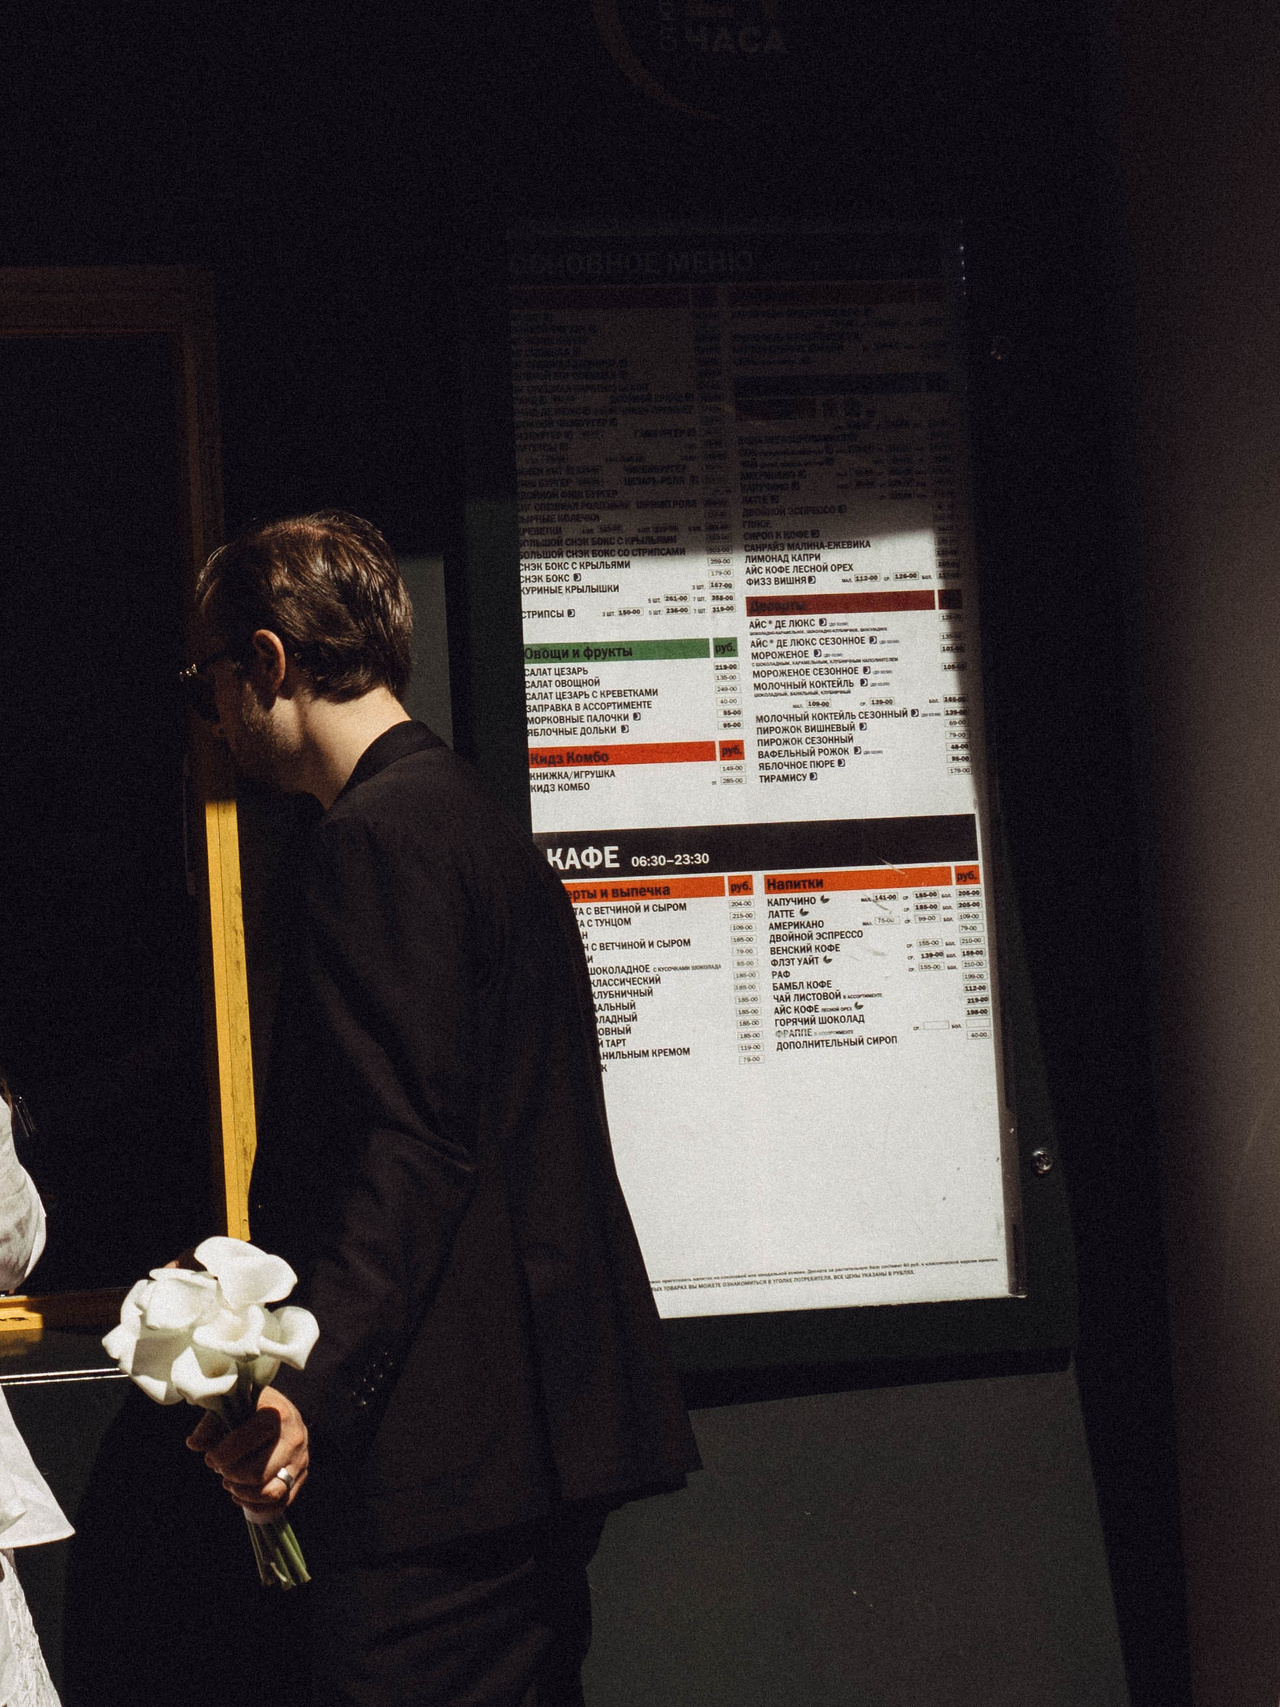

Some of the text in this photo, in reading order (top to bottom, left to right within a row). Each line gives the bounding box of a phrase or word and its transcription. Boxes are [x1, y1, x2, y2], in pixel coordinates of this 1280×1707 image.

[787, 539, 871, 551] МАЛИНА-ЕЖЕВИКА
[566, 549, 590, 559] СНЭК
[592, 548, 616, 558] БОКС
[617, 548, 630, 558] СО
[632, 546, 686, 557] СТРИПСАМИ
[745, 553, 821, 565] ЛИМОНАД КАПРИ
[520, 560, 631, 572] СНЭК БОКС С КРЫЛЬЯМИ
[745, 562, 854, 575] АЙС КОФЕ ЛЕСНОЙ ОРЕХ
[520, 573, 570, 583] СНЭК БОКС
[746, 576, 807, 586] ФИЗЗ ВИШНЯ
[520, 584, 620, 595] КУРИНЫЕ КРЫЛЫШКИ
[521, 609, 565, 619] СТРИПСЫ
[749, 618, 767, 629] АЙС
[775, 618, 786, 629] ДЕ
[788, 618, 816, 628] ЛЮКС
[715, 642, 735, 654] руб.
[750, 637, 768, 648] АЙС
[776, 638, 788, 649] ДЕ
[790, 637, 817, 647] ЛЮКС
[819, 636, 866, 646] СЕЗОННОЕ
[525, 645, 633, 660] Овощи и фрукты
[751, 650, 809, 660] МОРОЖЕНОЕ
[524, 667, 589, 677] САЛАТ ЦЕЗАРЬ
[752, 666, 859, 678] МОРОЖЕНОЕ СЕЗОННОЕ
[525, 678, 601, 689] САЛАТ ОВОЩНОЙ
[753, 678, 855, 691] МОЛОЧНЫЙ КОКТЕЙЛЬ
[526, 688, 659, 701] САЛАТ ЦЕЗАРЬ С КРЕВЕТКАМИ
[527, 700, 653, 713] ЗАПРАВКА В АССОРТИМЕНТЕ
[527, 713, 629, 725] МОРКОВНЫЕ ПАЛОЧКИ
[755, 712, 809, 723] МОЛОЧНЫЙ
[811, 710, 857, 721] КОКТЕЙЛЬ
[858, 708, 908, 719] СЕЗОННЫЙ
[528, 725, 617, 737] ЯБЛОЧНЫЕ ДОЛЬКИ
[757, 721, 856, 735] ПИРОЖОК ВИШНЕВЫЙ
[757, 733, 854, 747] ПИРОЖОК СЕЗОННЫЙ
[567, 750, 609, 764] Комбо
[758, 746, 850, 759] ВАФЕЛЬНЫЙ РОЖОК
[758, 759, 835, 771] ЯБЛОЧНОЕ ПЮРЕ
[530, 769, 616, 781] КНИЖКА/ИГРУШКА
[759, 772, 808, 783] ТИРАМИСУ
[530, 782, 590, 793] КИДЗ КОМБО
[546, 845, 620, 871] КАФЕ
[956, 869, 978, 883] руб.
[730, 881, 752, 895] руб.
[767, 877, 824, 891] Напитки
[600, 887, 609, 898] и
[611, 884, 671, 899] выпечка
[767, 896, 817, 907] КАПУЧИНО
[586, 902, 687, 915] С ВЕТЧИНОЙ И СЫРОМ
[767, 909, 795, 919] ЛАТТЕ
[587, 918, 593, 928] С
[595, 917, 632, 929] ТУНЦОМ
[768, 920, 825, 931] АМЕРИКАНО
[769, 930, 863, 944] ДВОЙНОЙ ЭСПРЕССО
[591, 942, 597, 951] С
[599, 939, 646, 951] ВЕТЧИНОЙ
[648, 940, 654, 949] И
[656, 938, 691, 948] СЫРОМ
[770, 943, 841, 955] ВЕНСКИЙ КОФЕ
[770, 955, 819, 967] ФЛЭТ УАЙТ
[589, 964, 651, 975] ШОКОЛАДНОЕ
[771, 970, 791, 979] РАФ
[591, 976, 661, 988] КЛАССИЧЕСКИЙ
[772, 980, 833, 991] БАМБЛ КОФЕ
[773, 991, 791, 1003] ЧАЙ
[793, 990, 842, 1002] ЛИСТОВОЙ
[773, 1003, 792, 1015] АЙС
[793, 1004, 820, 1014] КОФЕ
[774, 1014, 865, 1027] ГОРЯЧИЙ ШОКОЛАД
[775, 1028, 813, 1038] ФРАППЕ
[605, 1038, 627, 1048] ТАРТ
[776, 1035, 898, 1051] ДОПОЛНИТЕЛЬНЫЙ СИРОП
[651, 1047, 691, 1058] КРЕМОМ
